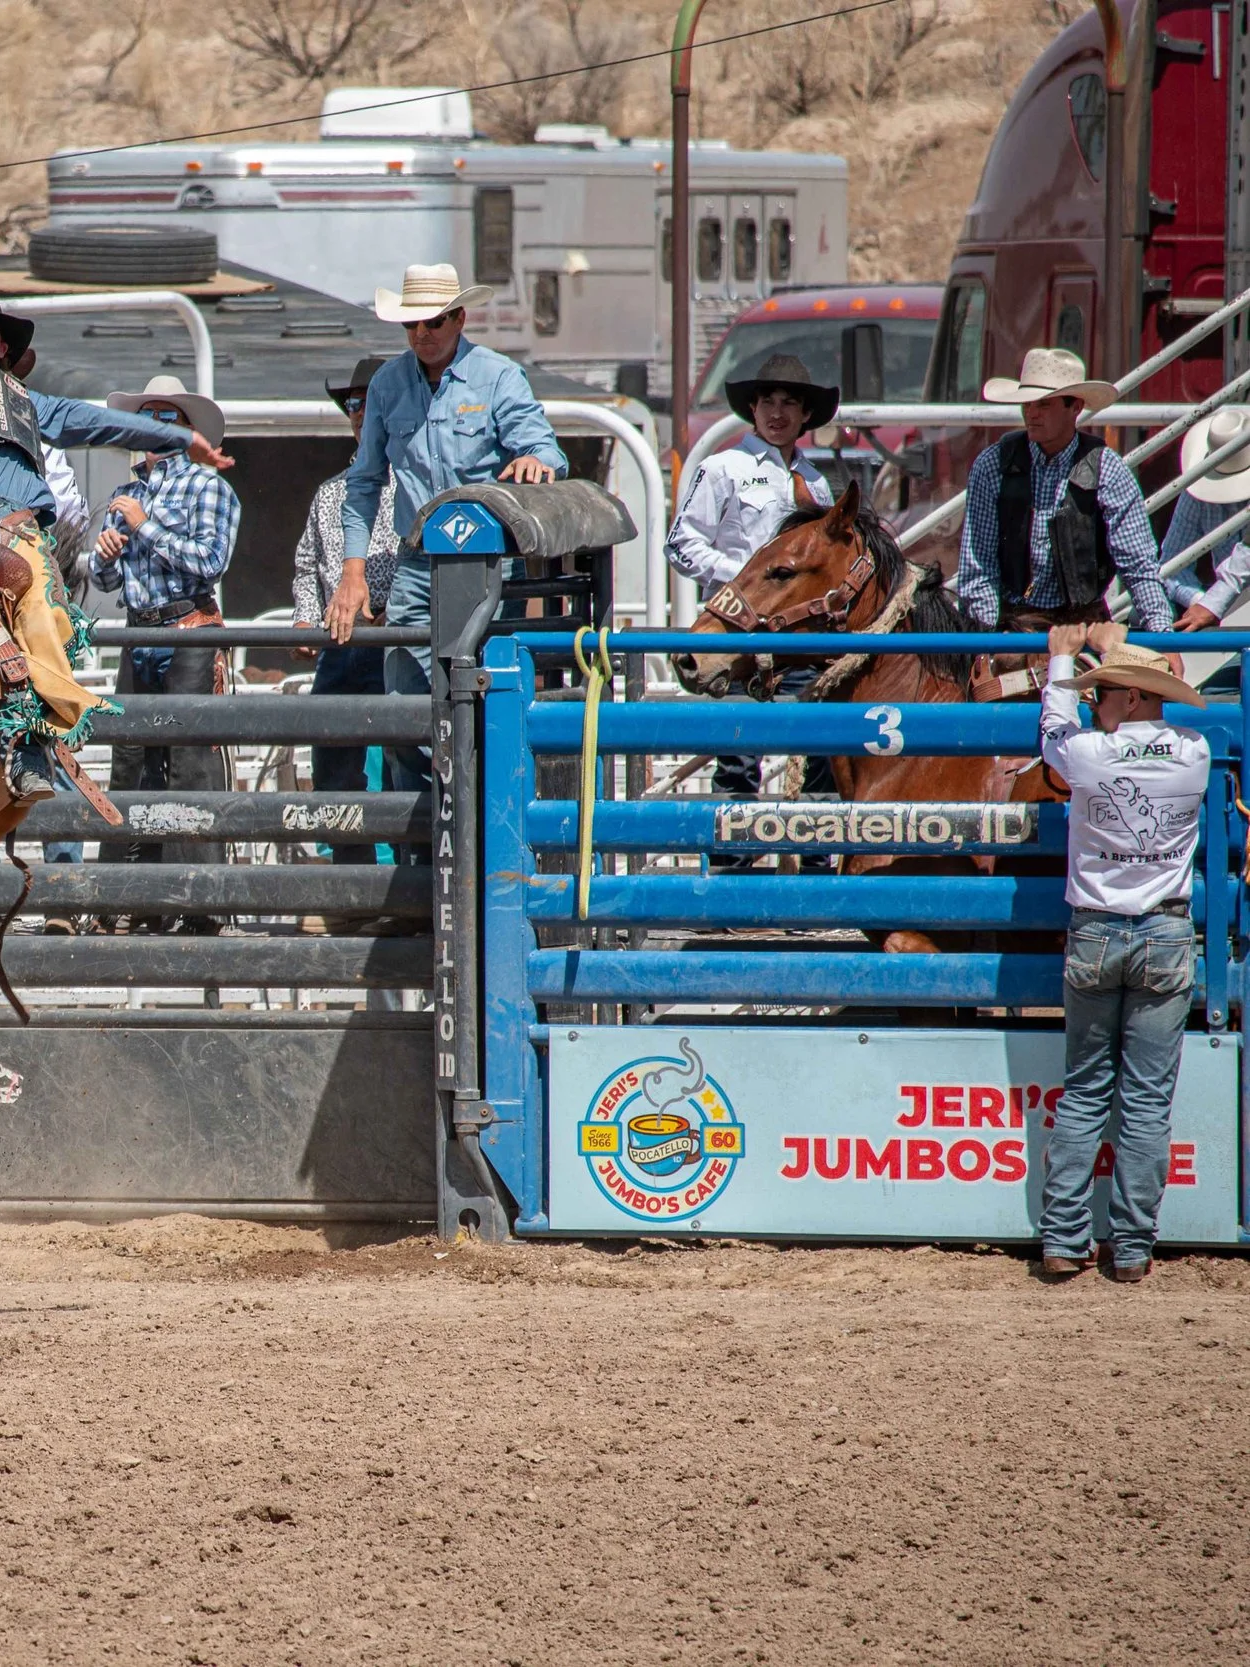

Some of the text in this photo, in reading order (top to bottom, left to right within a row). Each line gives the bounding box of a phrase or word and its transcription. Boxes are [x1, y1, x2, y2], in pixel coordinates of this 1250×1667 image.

[863, 705, 905, 756] 3
[1143, 744, 1173, 757] ABI
[981, 805, 1031, 844] ID
[1100, 851, 1108, 860] A
[1111, 853, 1161, 863] BETTER
[439, 1053, 456, 1078] ID
[596, 1072, 639, 1120] JERI'S
[588, 1138, 611, 1148] 1966
[589, 1129, 612, 1139] Since
[710, 1131, 736, 1148] 60
[631, 1139, 689, 1161] POCATELLO
[781, 1137, 1027, 1182] JUMBOS
[599, 1159, 728, 1214] JUMBO'S CAFE
